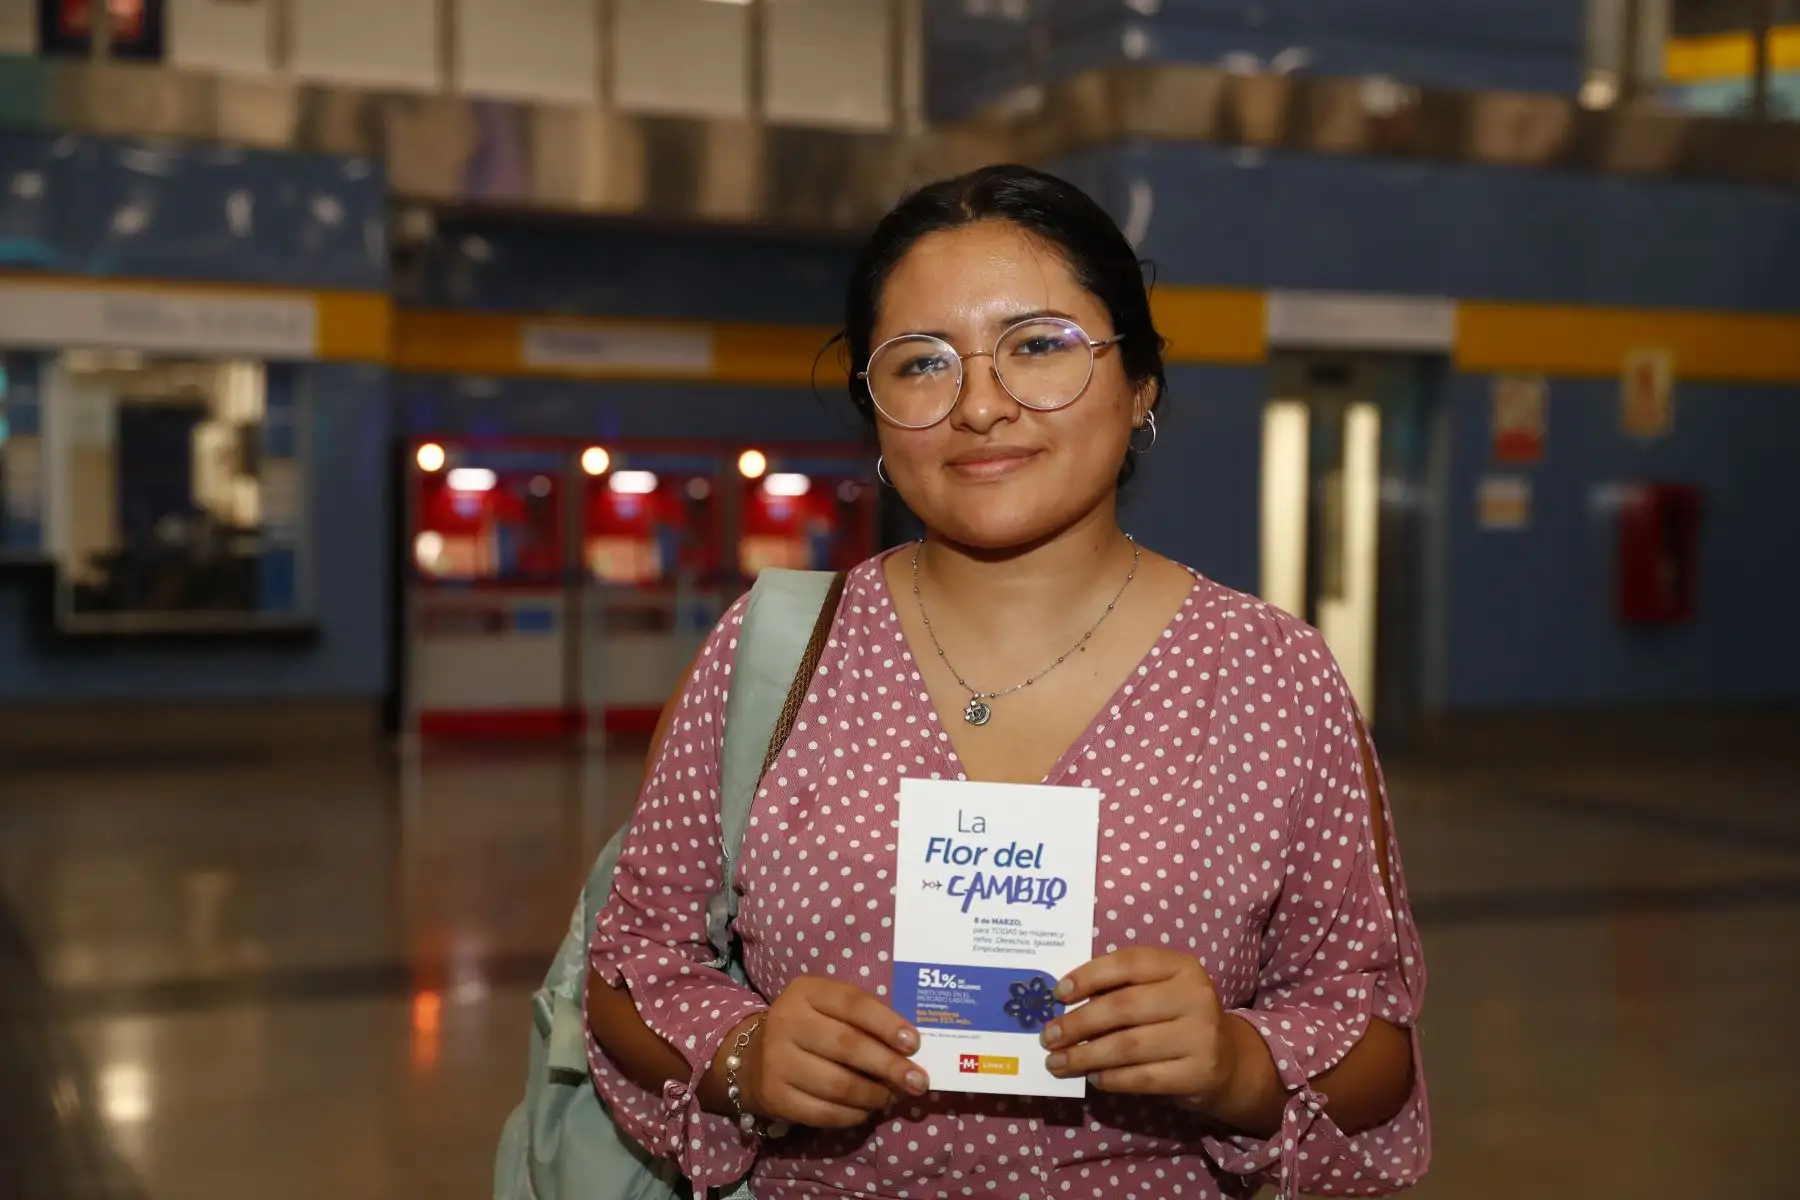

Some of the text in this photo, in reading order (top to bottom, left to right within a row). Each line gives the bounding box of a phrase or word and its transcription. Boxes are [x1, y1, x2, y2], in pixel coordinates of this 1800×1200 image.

[957, 809, 986, 833] La
[925, 837, 1044, 869] Flor del
[947, 871, 1067, 914] CAMBIO
[973, 926, 989, 934] para
[991, 927, 1017, 935] TODAS
[1018, 928, 1028, 936] las
[1029, 930, 1058, 938] mujeres
[917, 968, 957, 989] 51%
